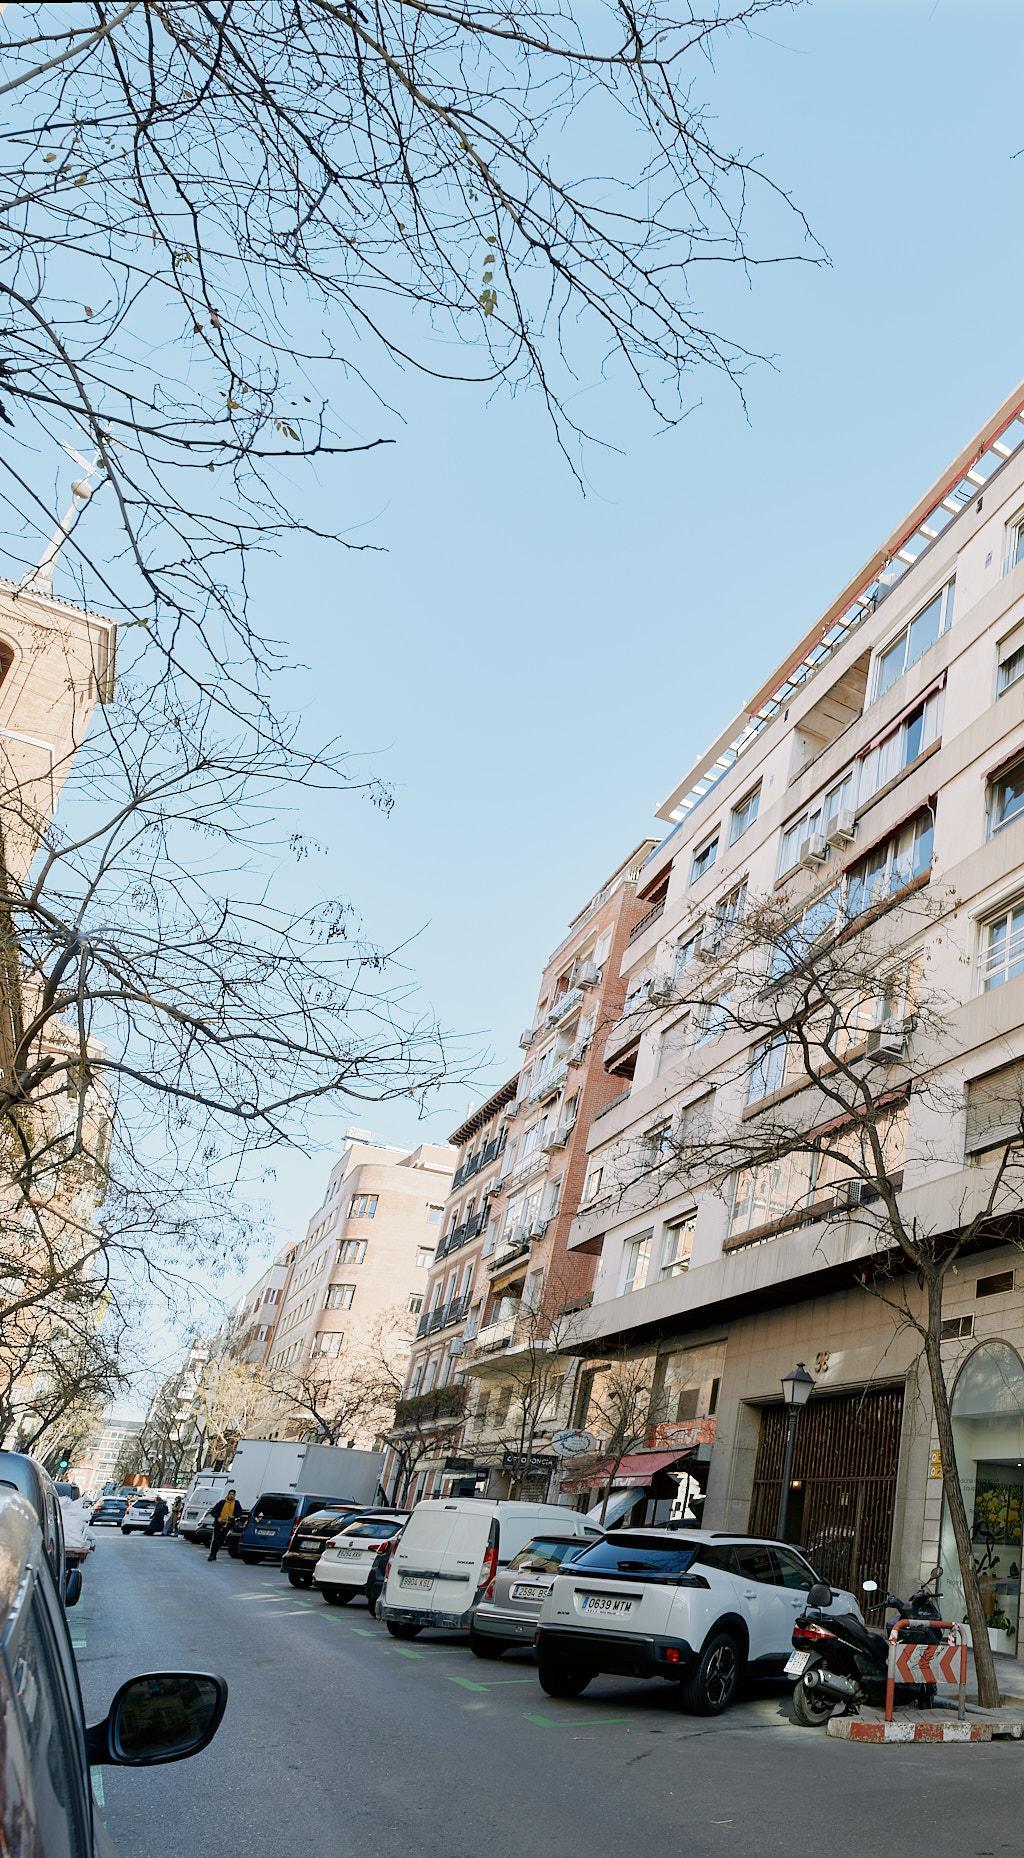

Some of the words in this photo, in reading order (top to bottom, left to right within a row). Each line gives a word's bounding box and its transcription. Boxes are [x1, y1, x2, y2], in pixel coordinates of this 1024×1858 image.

[815, 1350, 831, 1374] 98
[519, 1587, 536, 1597] 2594
[588, 1598, 612, 1610] 0639
[613, 1600, 632, 1612] MTM
